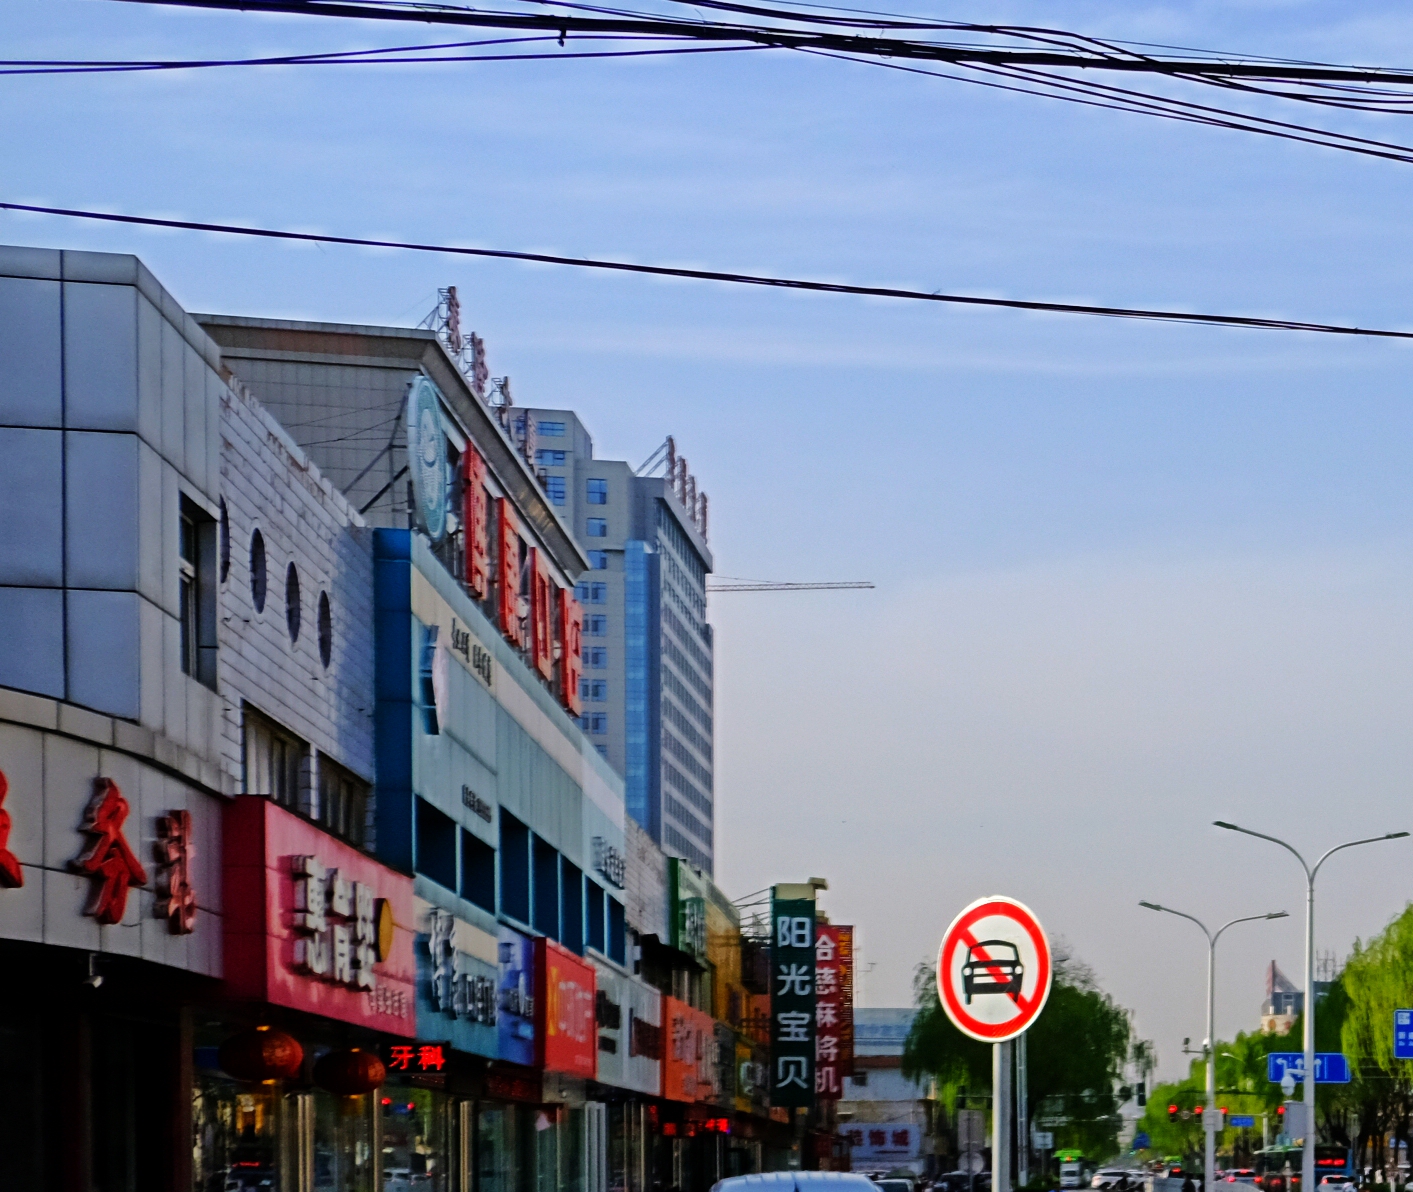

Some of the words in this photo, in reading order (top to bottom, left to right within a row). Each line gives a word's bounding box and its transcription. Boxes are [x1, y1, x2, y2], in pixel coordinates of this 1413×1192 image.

[777, 915, 811, 1090] 阳光宝贝
[388, 1045, 447, 1071] 牙科
